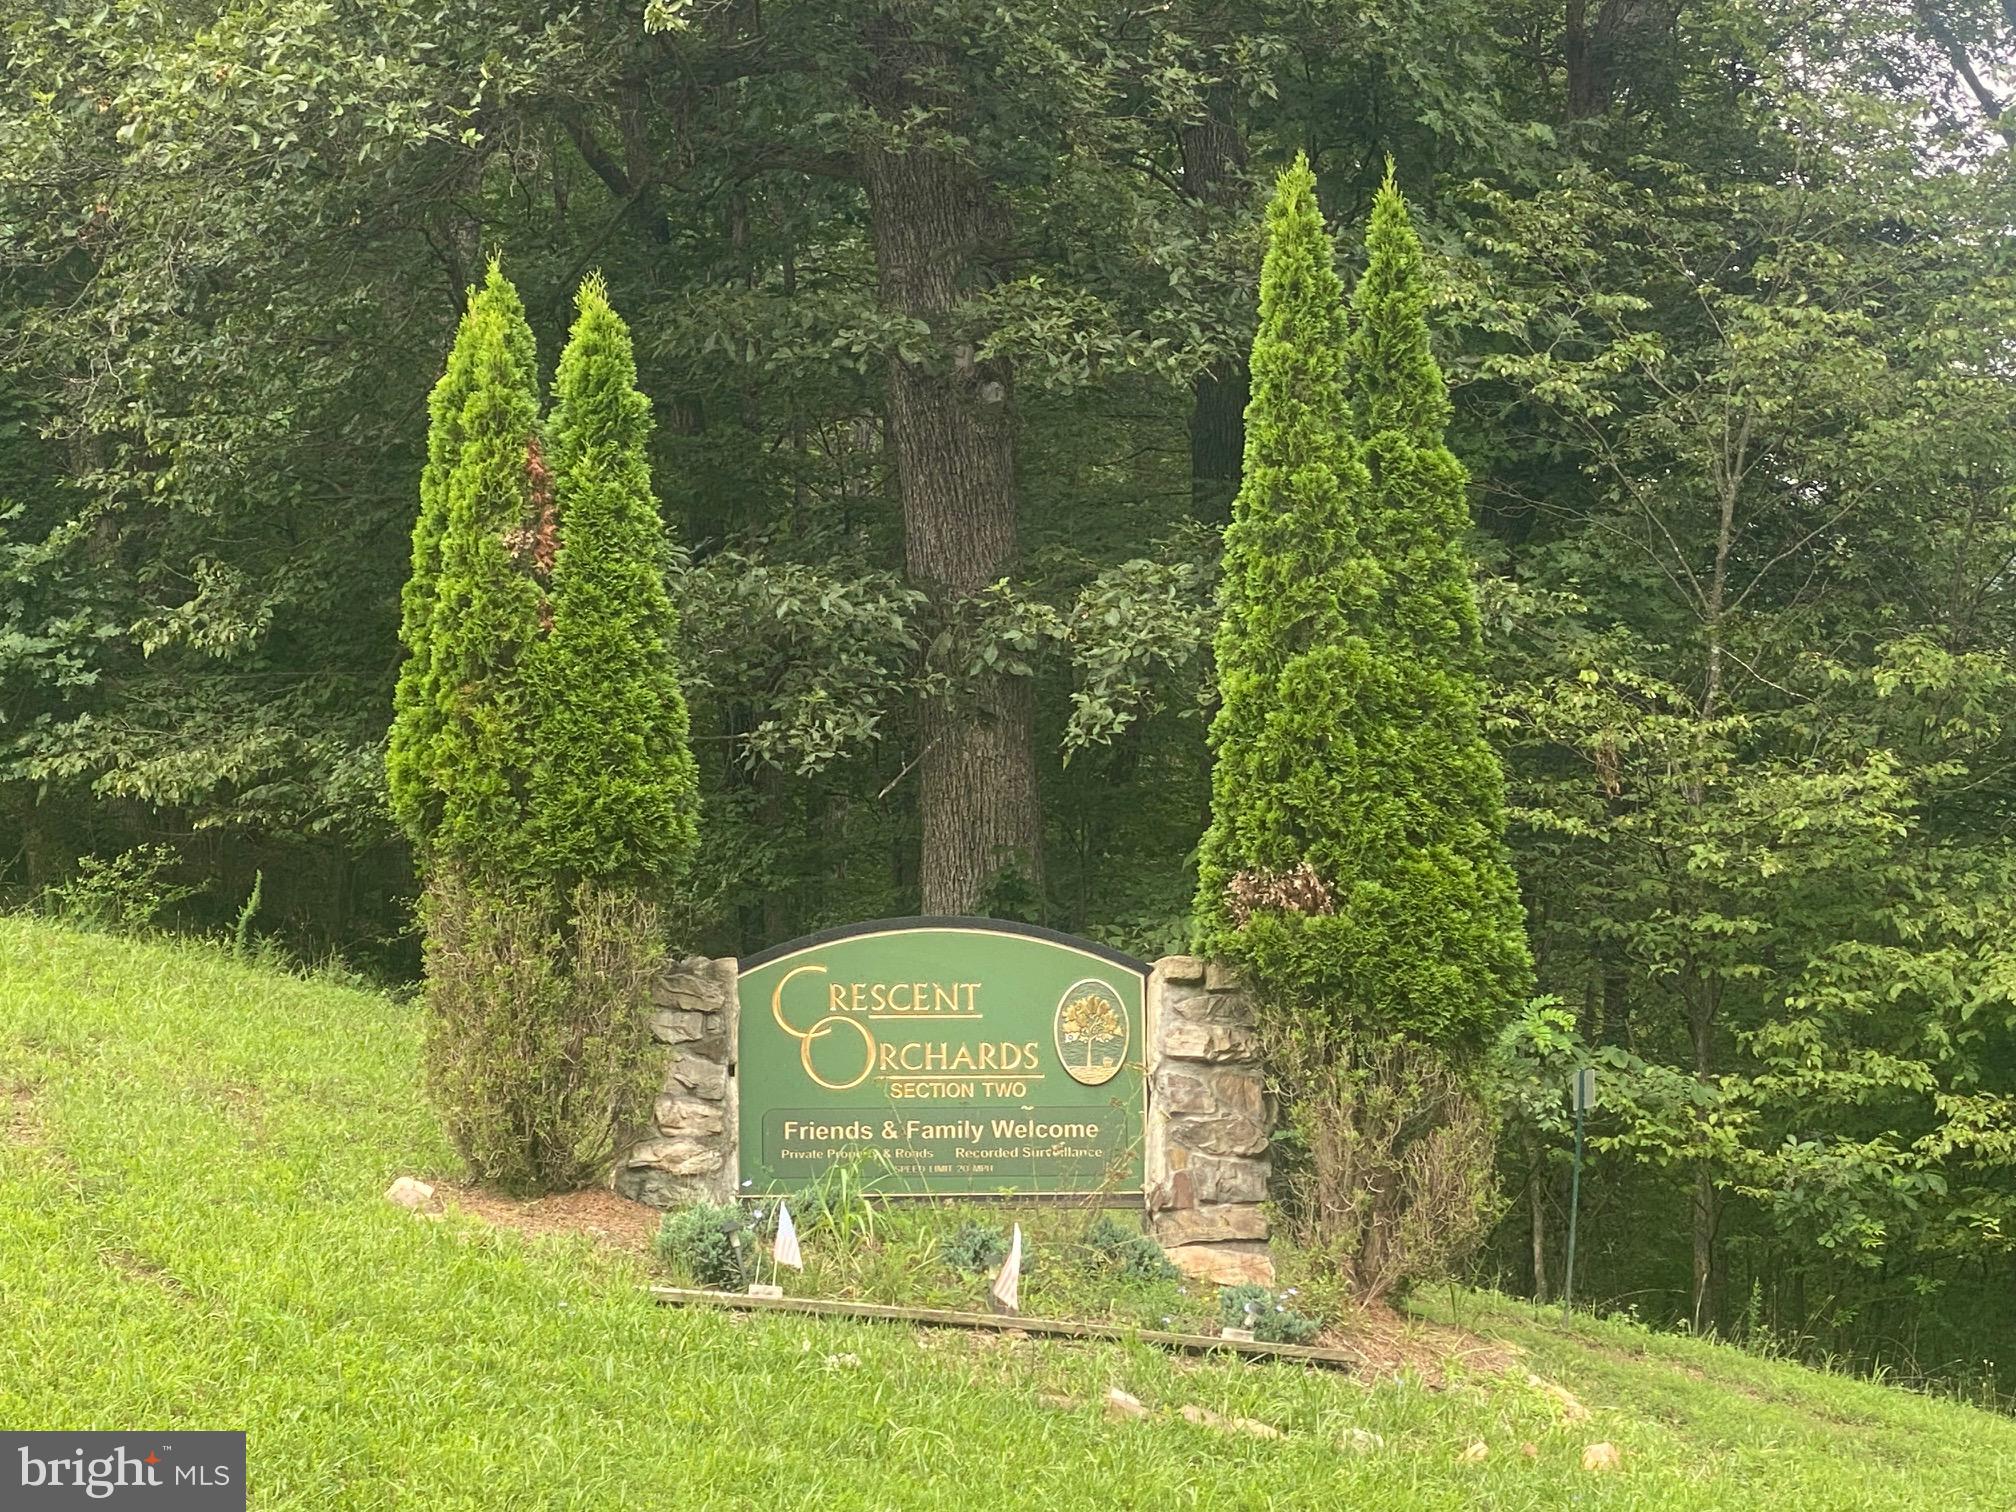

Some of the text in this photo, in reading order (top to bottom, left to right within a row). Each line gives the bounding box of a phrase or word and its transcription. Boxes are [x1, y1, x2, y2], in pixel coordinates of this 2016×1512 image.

[771, 965, 982, 1038] CRESCENT
[800, 1015, 1040, 1090] ORCHARDS
[890, 1082, 1027, 1099] SECTION TWO
[784, 1119, 1099, 1144] Friends & Family Welcome
[781, 1149, 824, 1159] Private
[883, 1149, 892, 1159] &
[955, 1147, 1019, 1158] Recorded
